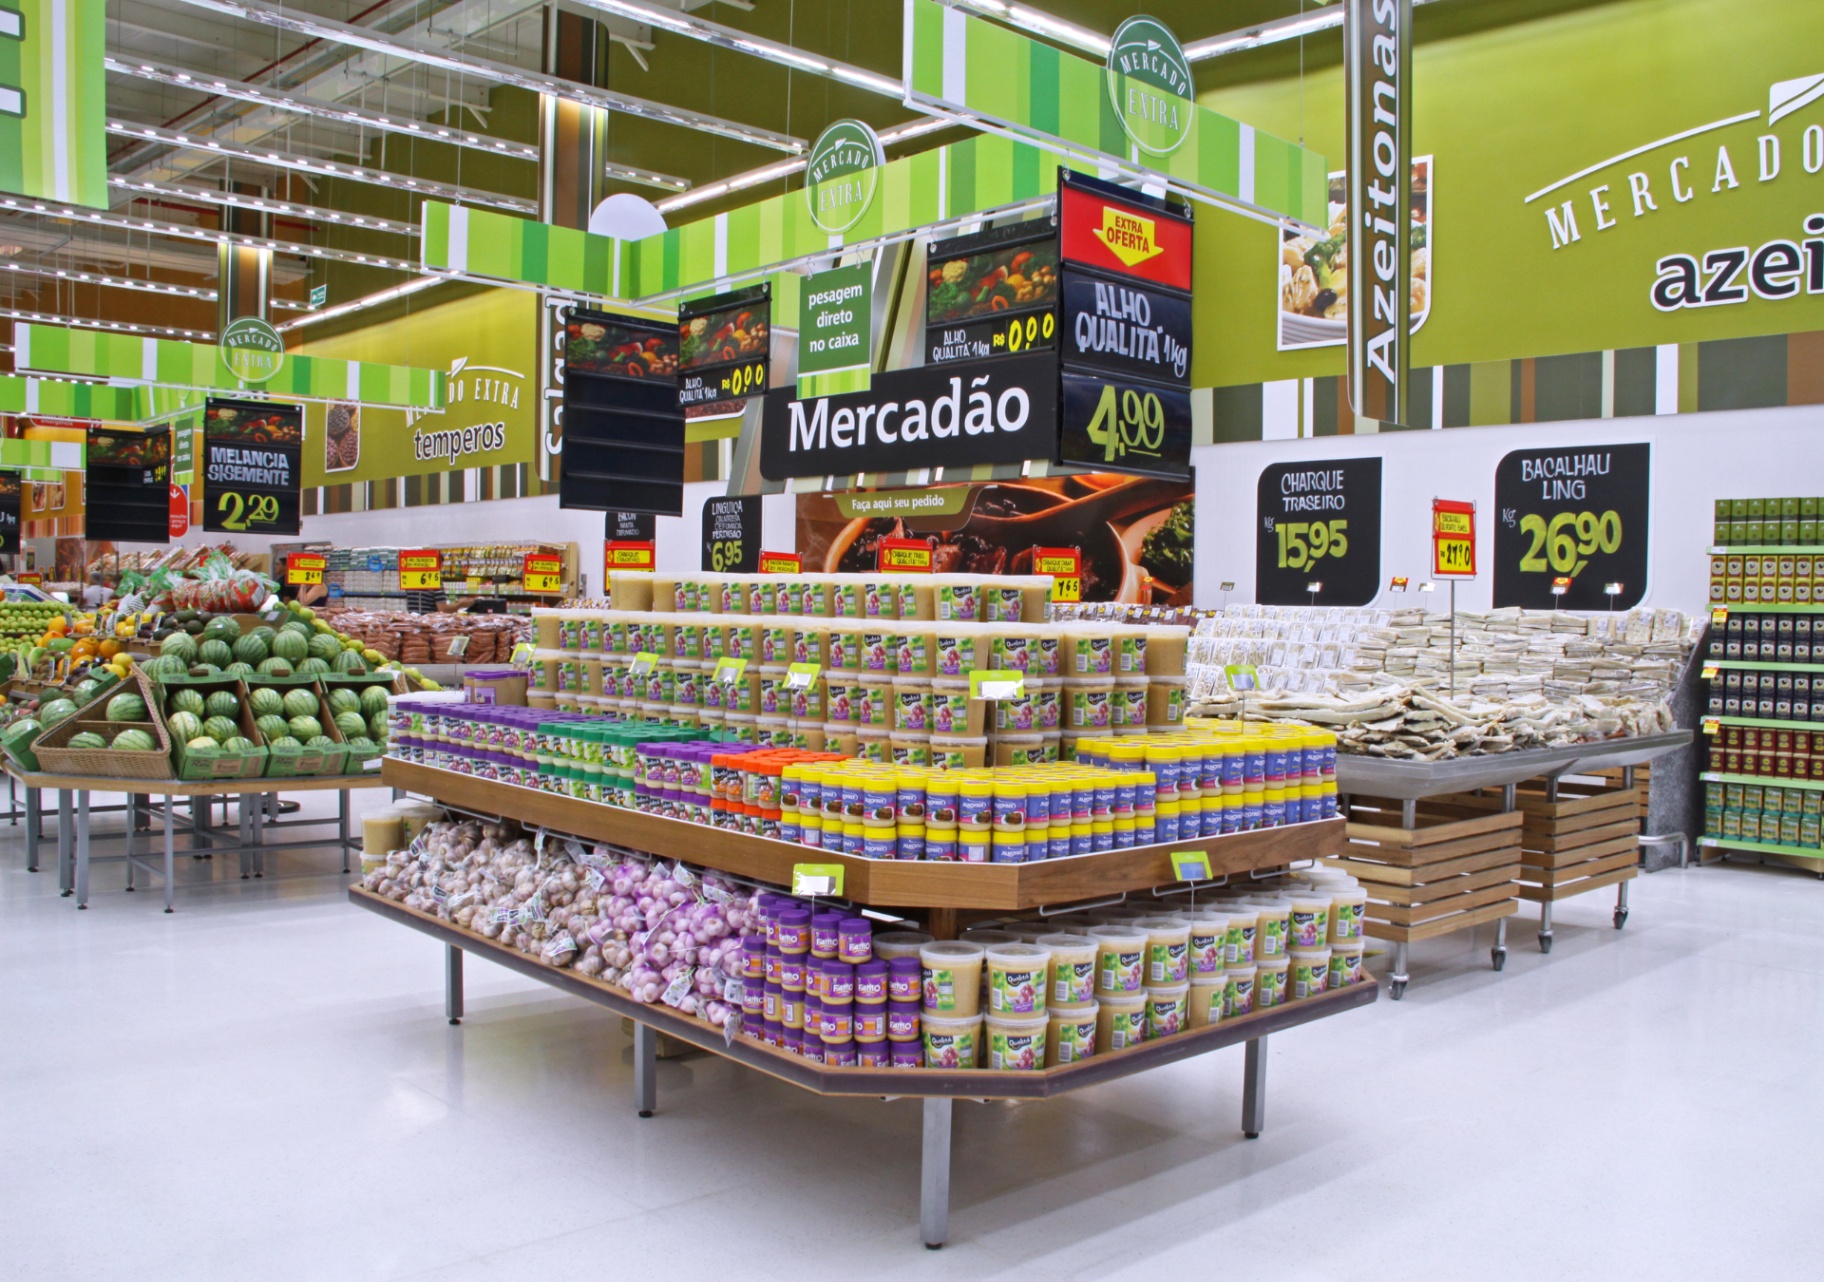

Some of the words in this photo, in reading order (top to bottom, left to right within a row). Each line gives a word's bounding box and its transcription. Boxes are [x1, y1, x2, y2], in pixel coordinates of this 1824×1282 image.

[1120, 52, 1187, 95] MERCADO
[1128, 87, 1179, 130] EXTRA
[813, 149, 870, 183] MERCADO
[820, 180, 863, 212] EXTRA
[1365, 0, 1397, 384] Azeitonas
[1544, 123, 1824, 250] MERCADO
[1115, 215, 1143, 234] EXTRA
[1106, 226, 1150, 253] OFERTA
[808, 284, 863, 310] pesagem
[1095, 282, 1151, 327] ALHO
[816, 308, 853, 329] direto
[228, 334, 278, 352] MERCADO
[809, 338, 826, 353] no
[828, 331, 859, 350] caixa
[943, 329, 966, 346] ALHO
[993, 333, 1005, 347] R$
[234, 352, 272, 369] EXTRA
[1164, 334, 1187, 378] 1kg
[474, 377, 519, 410] EXTRA
[685, 377, 702, 390] ALHO
[721, 378, 731, 390] R$
[788, 375, 1030, 452] Mercadão
[413, 421, 505, 465] temperos
[211, 446, 289, 470] MELANCIA
[1521, 453, 1611, 482] BACALHAU
[1281, 470, 1344, 495] CHARQUE
[1542, 479, 1586, 500] LING
[711, 500, 743, 516] LINGUIÇA
[851, 499, 871, 512] Faça
[873, 497, 892, 511] aqui
[894, 499, 910, 509] seu
[912, 494, 945, 510] pedido
[1283, 494, 1345, 511] TRASEIRO
[1275, 519, 1348, 573] 15,95
[1519, 509, 1622, 578] 26,90
